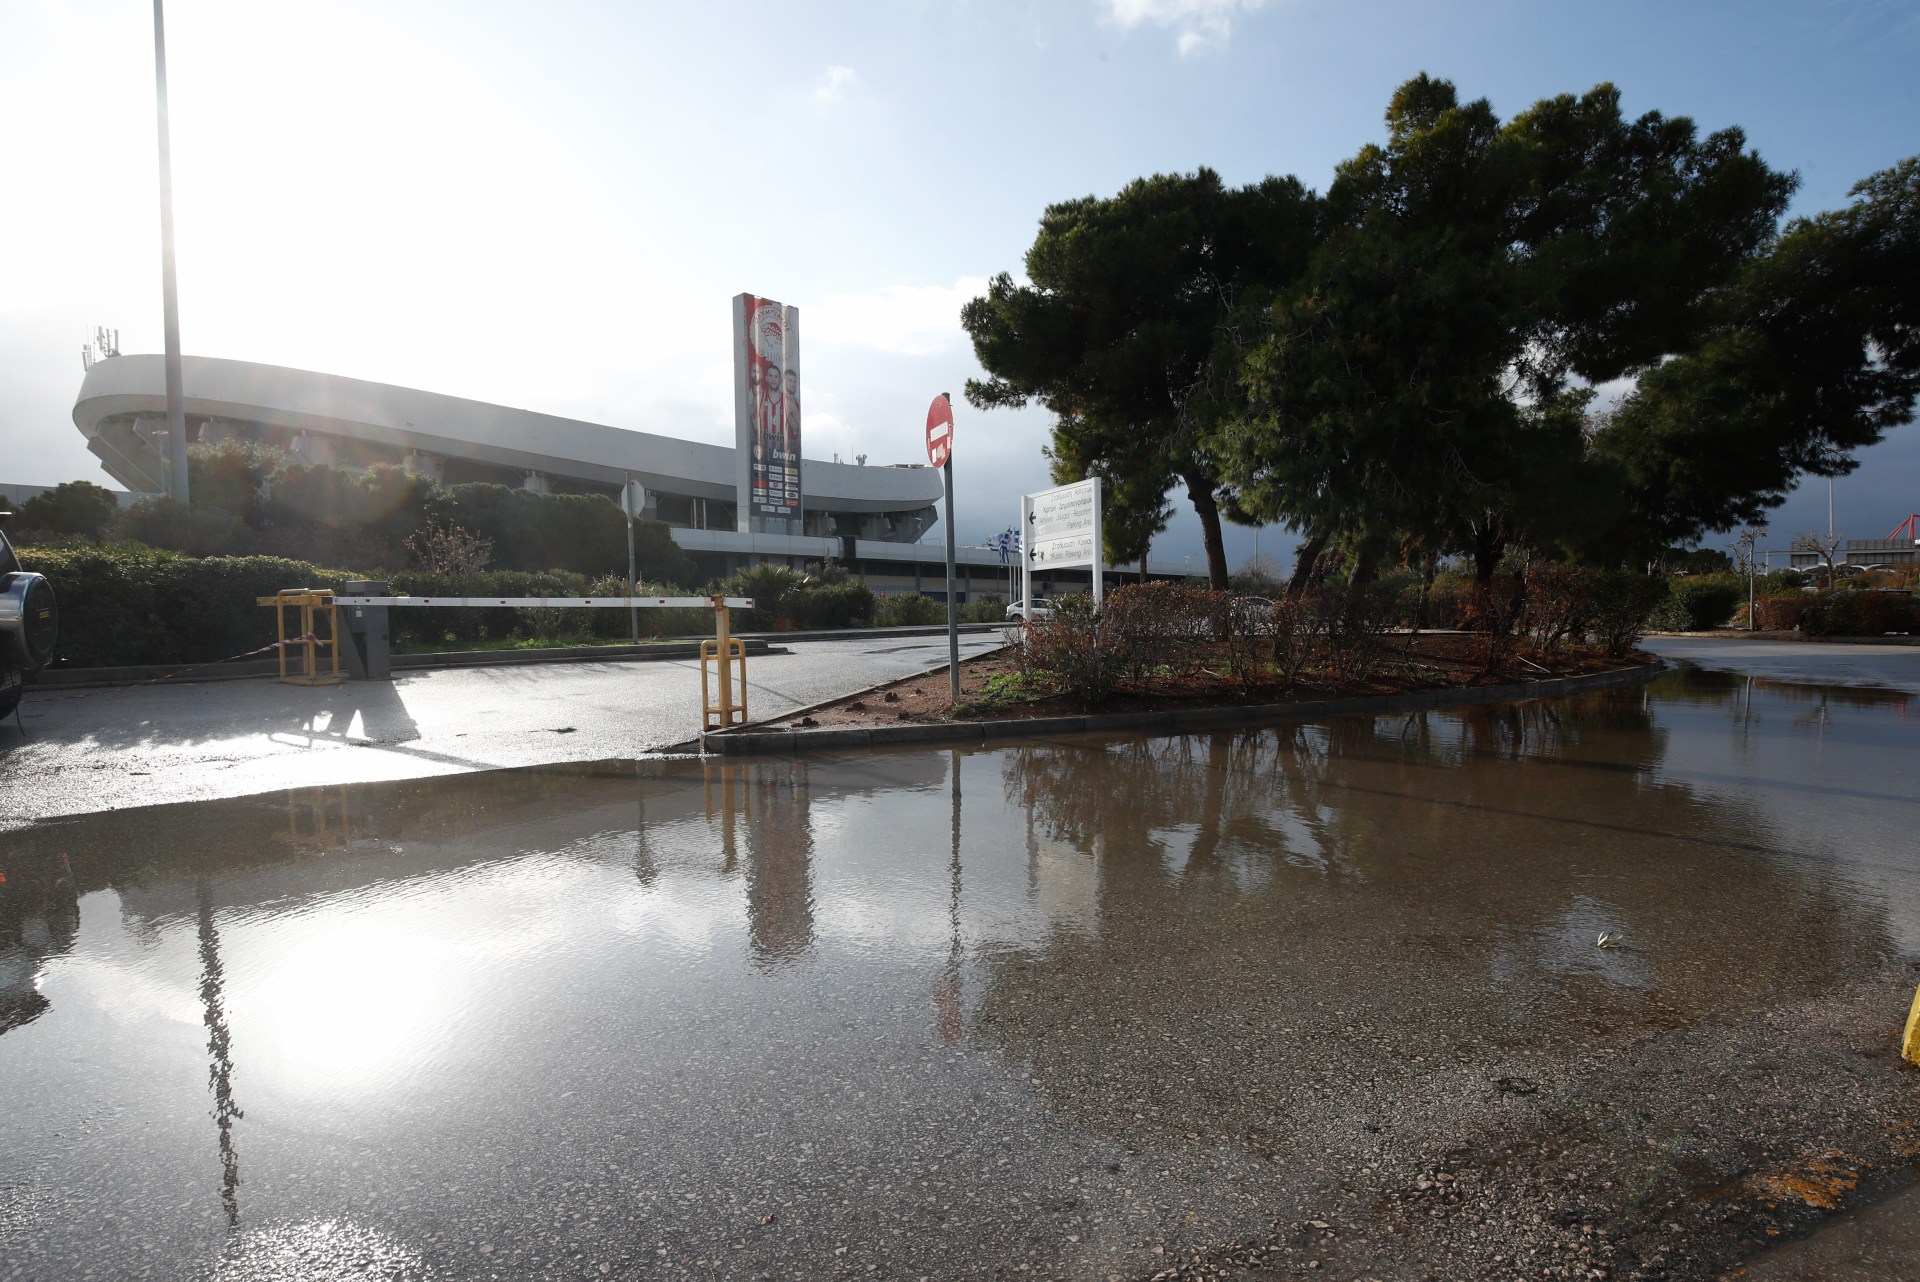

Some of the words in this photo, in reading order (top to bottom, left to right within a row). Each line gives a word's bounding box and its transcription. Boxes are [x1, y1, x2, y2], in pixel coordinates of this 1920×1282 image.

[763, 429, 785, 442] bwin
[772, 448, 796, 461] bwin
[1066, 521, 1081, 529] Parking
[1065, 550, 1082, 558] Parking
